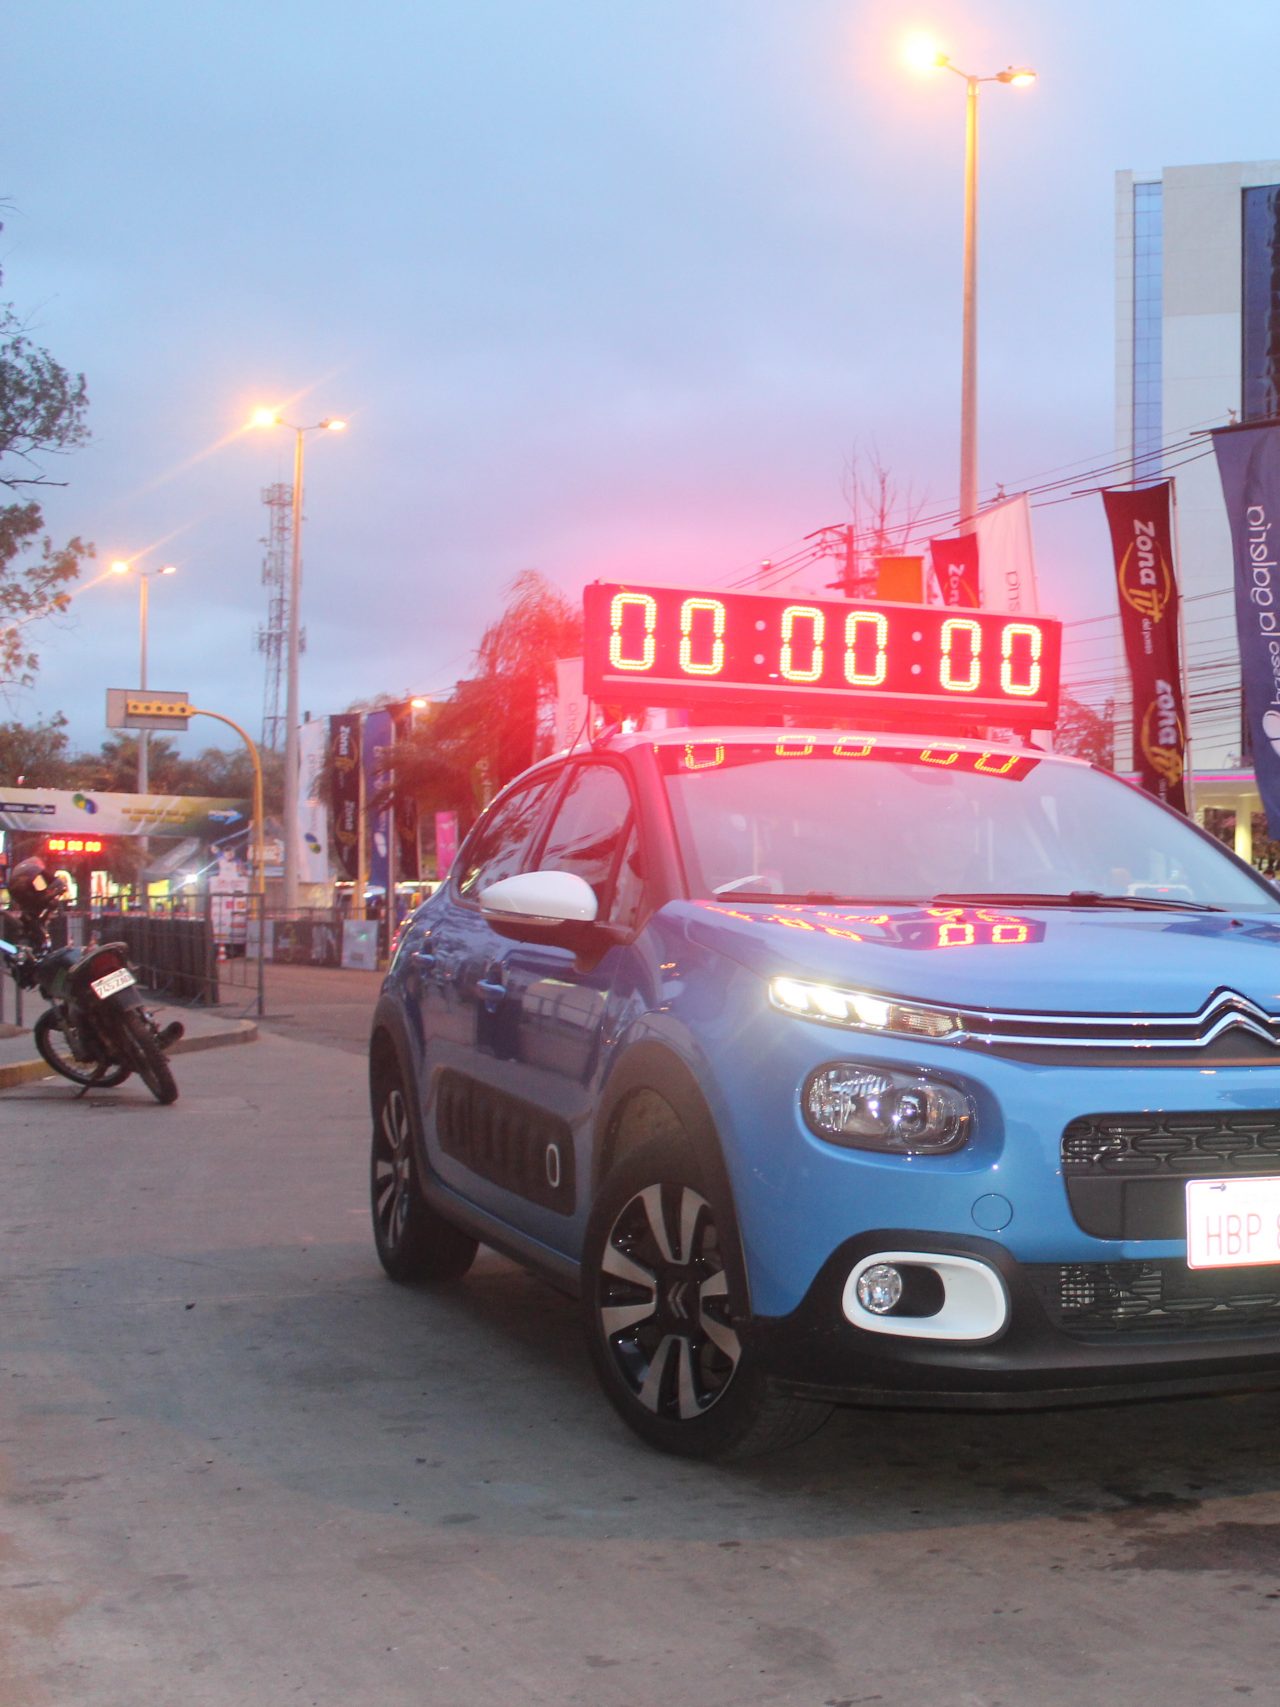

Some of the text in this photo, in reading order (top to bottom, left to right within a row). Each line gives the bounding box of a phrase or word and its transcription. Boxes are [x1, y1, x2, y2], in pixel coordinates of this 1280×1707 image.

[1133, 519, 1157, 586] Zona
[948, 563, 965, 607] Zon
[1206, 1213, 1263, 1257] HBP
